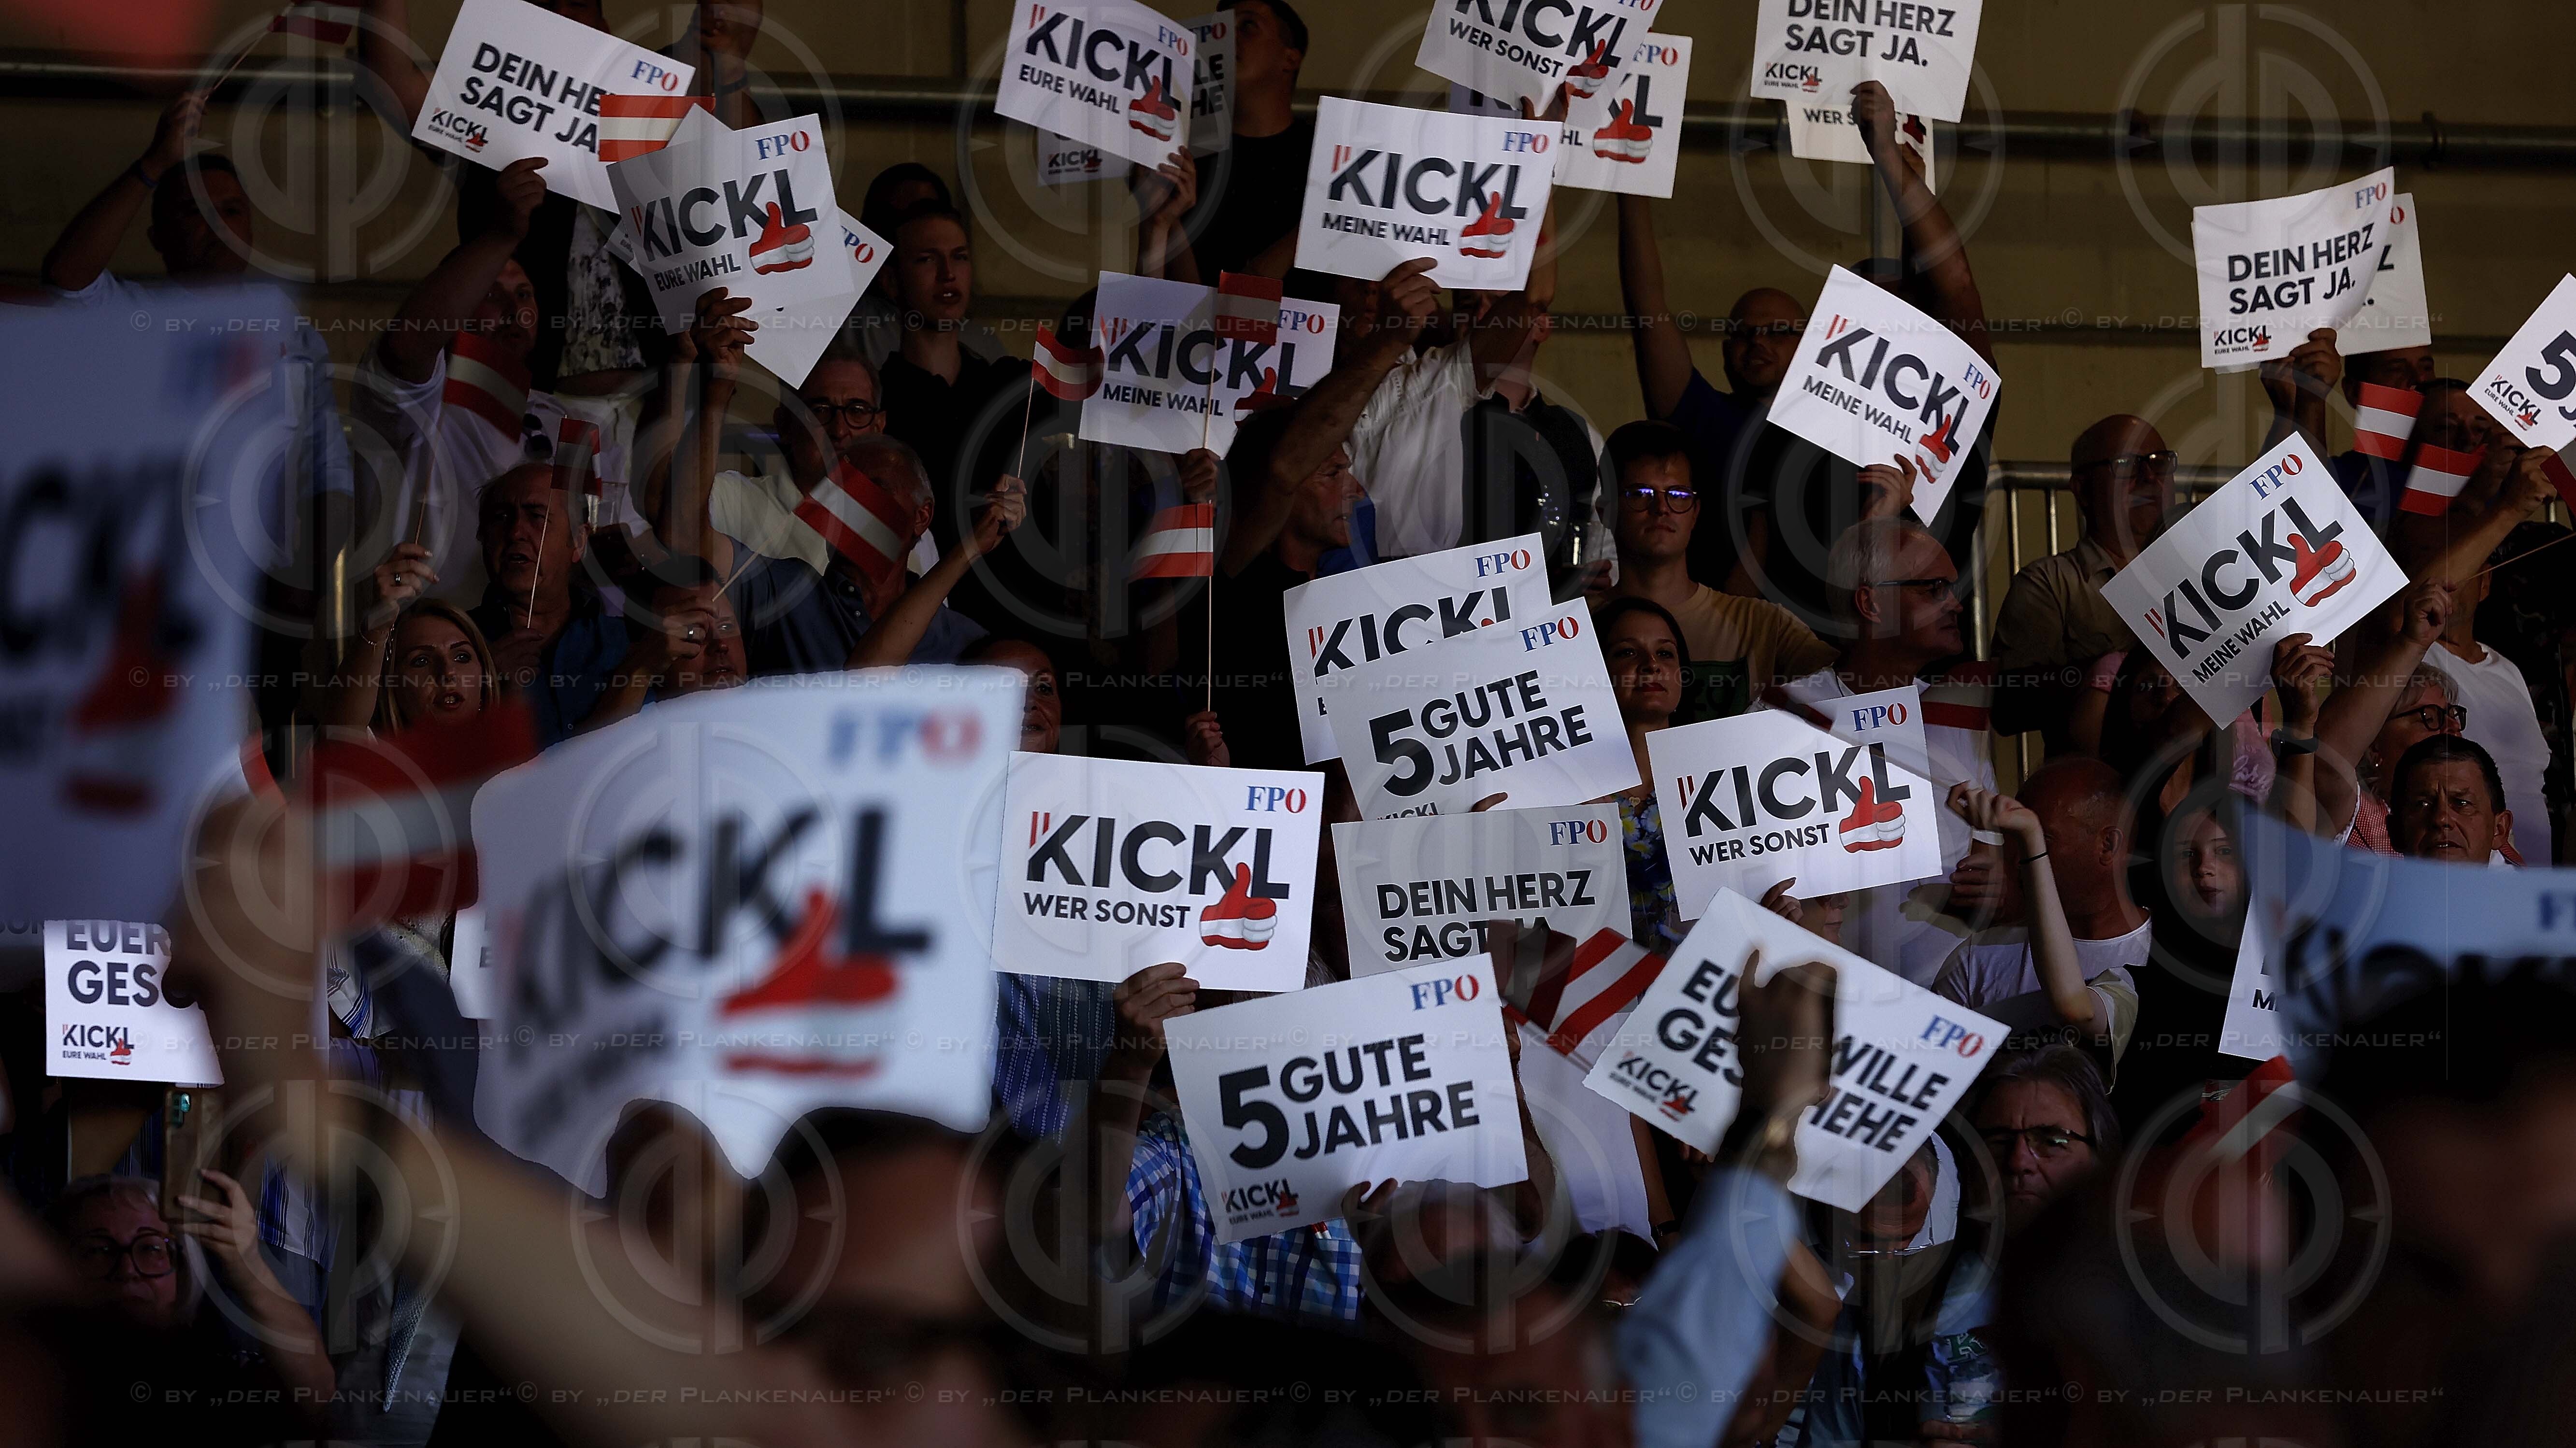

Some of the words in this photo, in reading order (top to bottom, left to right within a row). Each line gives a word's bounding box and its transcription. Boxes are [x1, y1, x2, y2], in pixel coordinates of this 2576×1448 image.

[1450, 18, 1493, 51] WER
[1495, 39, 1563, 78] SONST
[1785, 24, 1874, 57] SAGT
[1881, 34, 1928, 67] JA.
[1788, 0, 1866, 24] DEIN
[1874, 0, 1956, 37] HERZ
[472, 42, 558, 98] DEIN
[558, 76, 615, 116] HE
[1025, 3, 1182, 112] KICKL
[1765, 62, 1823, 83] KICKL
[460, 76, 555, 131] SAGT
[1019, 63, 1065, 93] EURE
[1069, 79, 1120, 114] WAHL
[1803, 108, 1842, 125] WER
[431, 107, 489, 143] KICKL
[1328, 143, 1529, 221] KICKL
[631, 169, 818, 262] KICKL
[1321, 212, 1388, 241] MEINE
[1392, 222, 1450, 247] WAHL
[654, 266, 686, 292] EURE
[683, 253, 741, 284] WAHL
[2228, 245, 2304, 283] DEIN
[2312, 222, 2375, 270] HERZ
[2230, 277, 2315, 314] SAGT
[2323, 266, 2356, 300] JA.
[1108, 317, 1308, 398] KICKL
[2214, 325, 2272, 347] KICKL
[2525, 330, 2576, 400] 5
[1103, 382, 1161, 408] MEINE
[1166, 391, 1224, 417] WAHL
[1802, 374, 1862, 416] MEINE
[1863, 403, 1914, 445] WAHL
[1815, 313, 1970, 456] KICKL
[2484, 388, 2499, 403] EURE
[2498, 399, 2514, 415] WAHL
[2490, 374, 2541, 425] KICKL
[2143, 496, 2345, 661] KICKL
[2190, 638, 2242, 685] MEINE
[2239, 600, 2291, 646] WAHL
[1420, 669, 1548, 739] GUTE
[1368, 708, 1435, 797] 5
[1437, 704, 1594, 786] JAHRE
[1676, 741, 1911, 838] KICKL
[1026, 811, 1290, 900] KICKL
[1688, 836, 1746, 866] WER
[1750, 823, 1830, 856] SONST
[1023, 893, 1088, 921] WER
[1094, 899, 1191, 928] SONST
[1376, 876, 1478, 920] DEIN
[1484, 869, 1596, 912] HERZ
[62, 1024, 135, 1050] KICKL
[83, 1051, 106, 1060] WAHL
[1280, 1033, 1431, 1104] GUTE
[1617, 1051, 1698, 1113] KICKL
[1218, 1065, 1290, 1170] 5
[1294, 1080, 1480, 1161] JAHRE
[1221, 1178, 1299, 1213] KICKL
